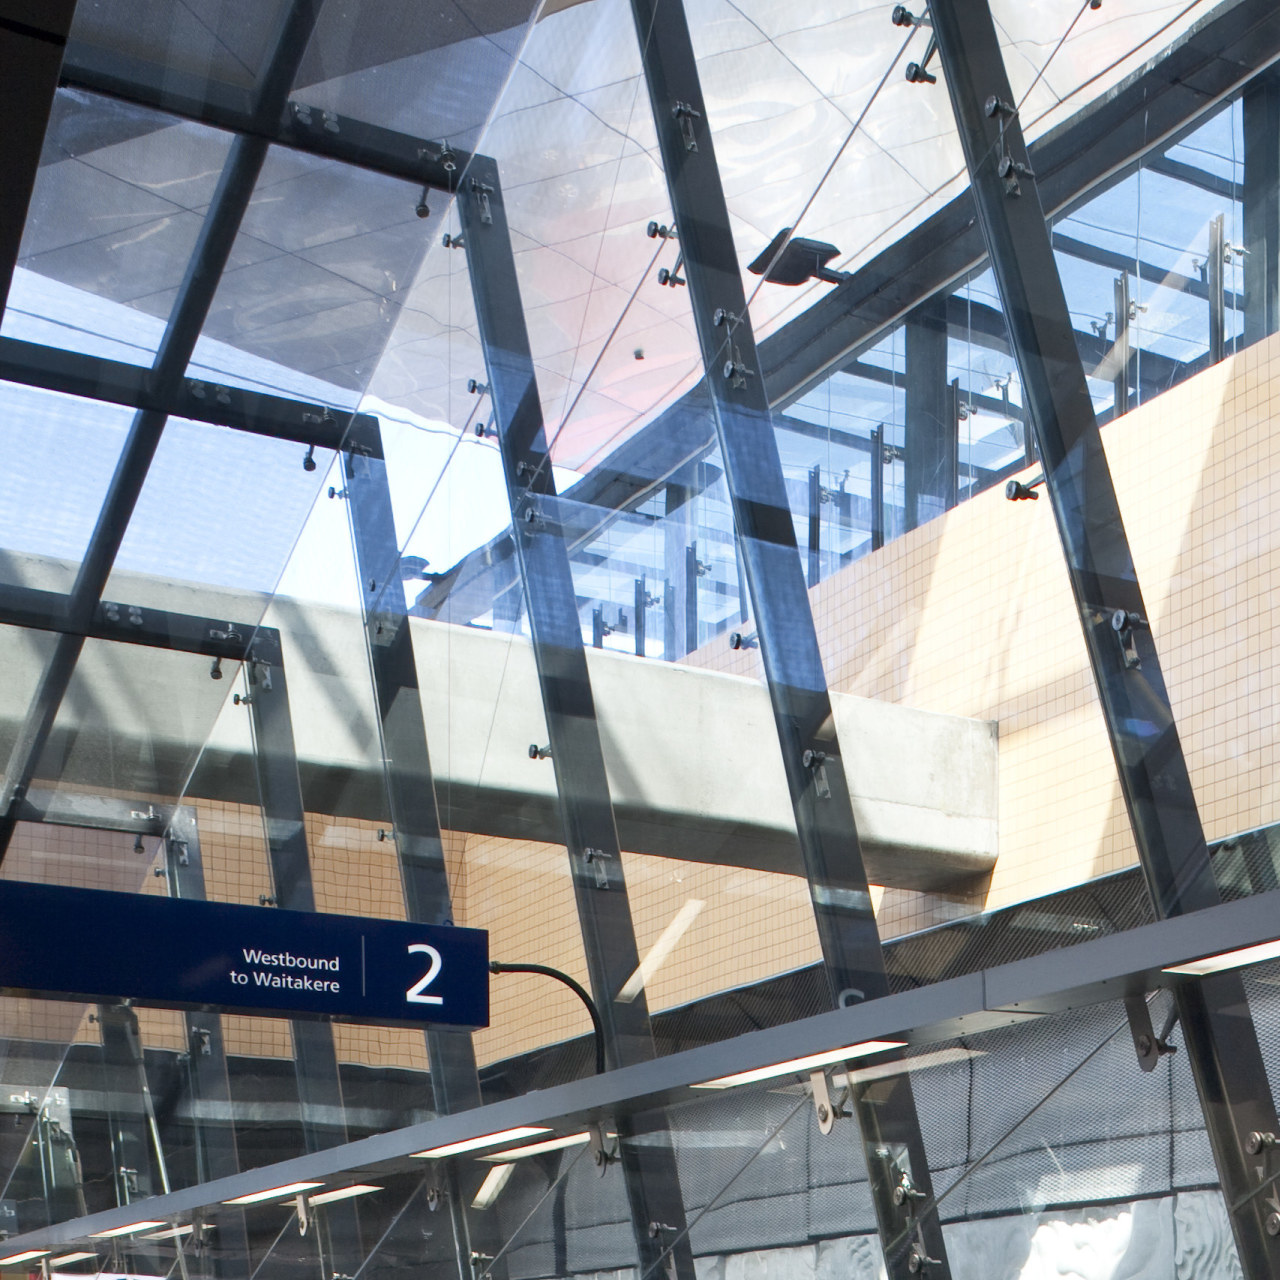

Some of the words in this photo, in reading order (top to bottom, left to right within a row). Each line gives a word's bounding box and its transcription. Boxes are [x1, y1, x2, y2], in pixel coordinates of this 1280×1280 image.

[242, 948, 340, 972] Westbound
[229, 970, 249, 985] to
[252, 971, 341, 993] Waitakere
[405, 943, 444, 1006] 2
